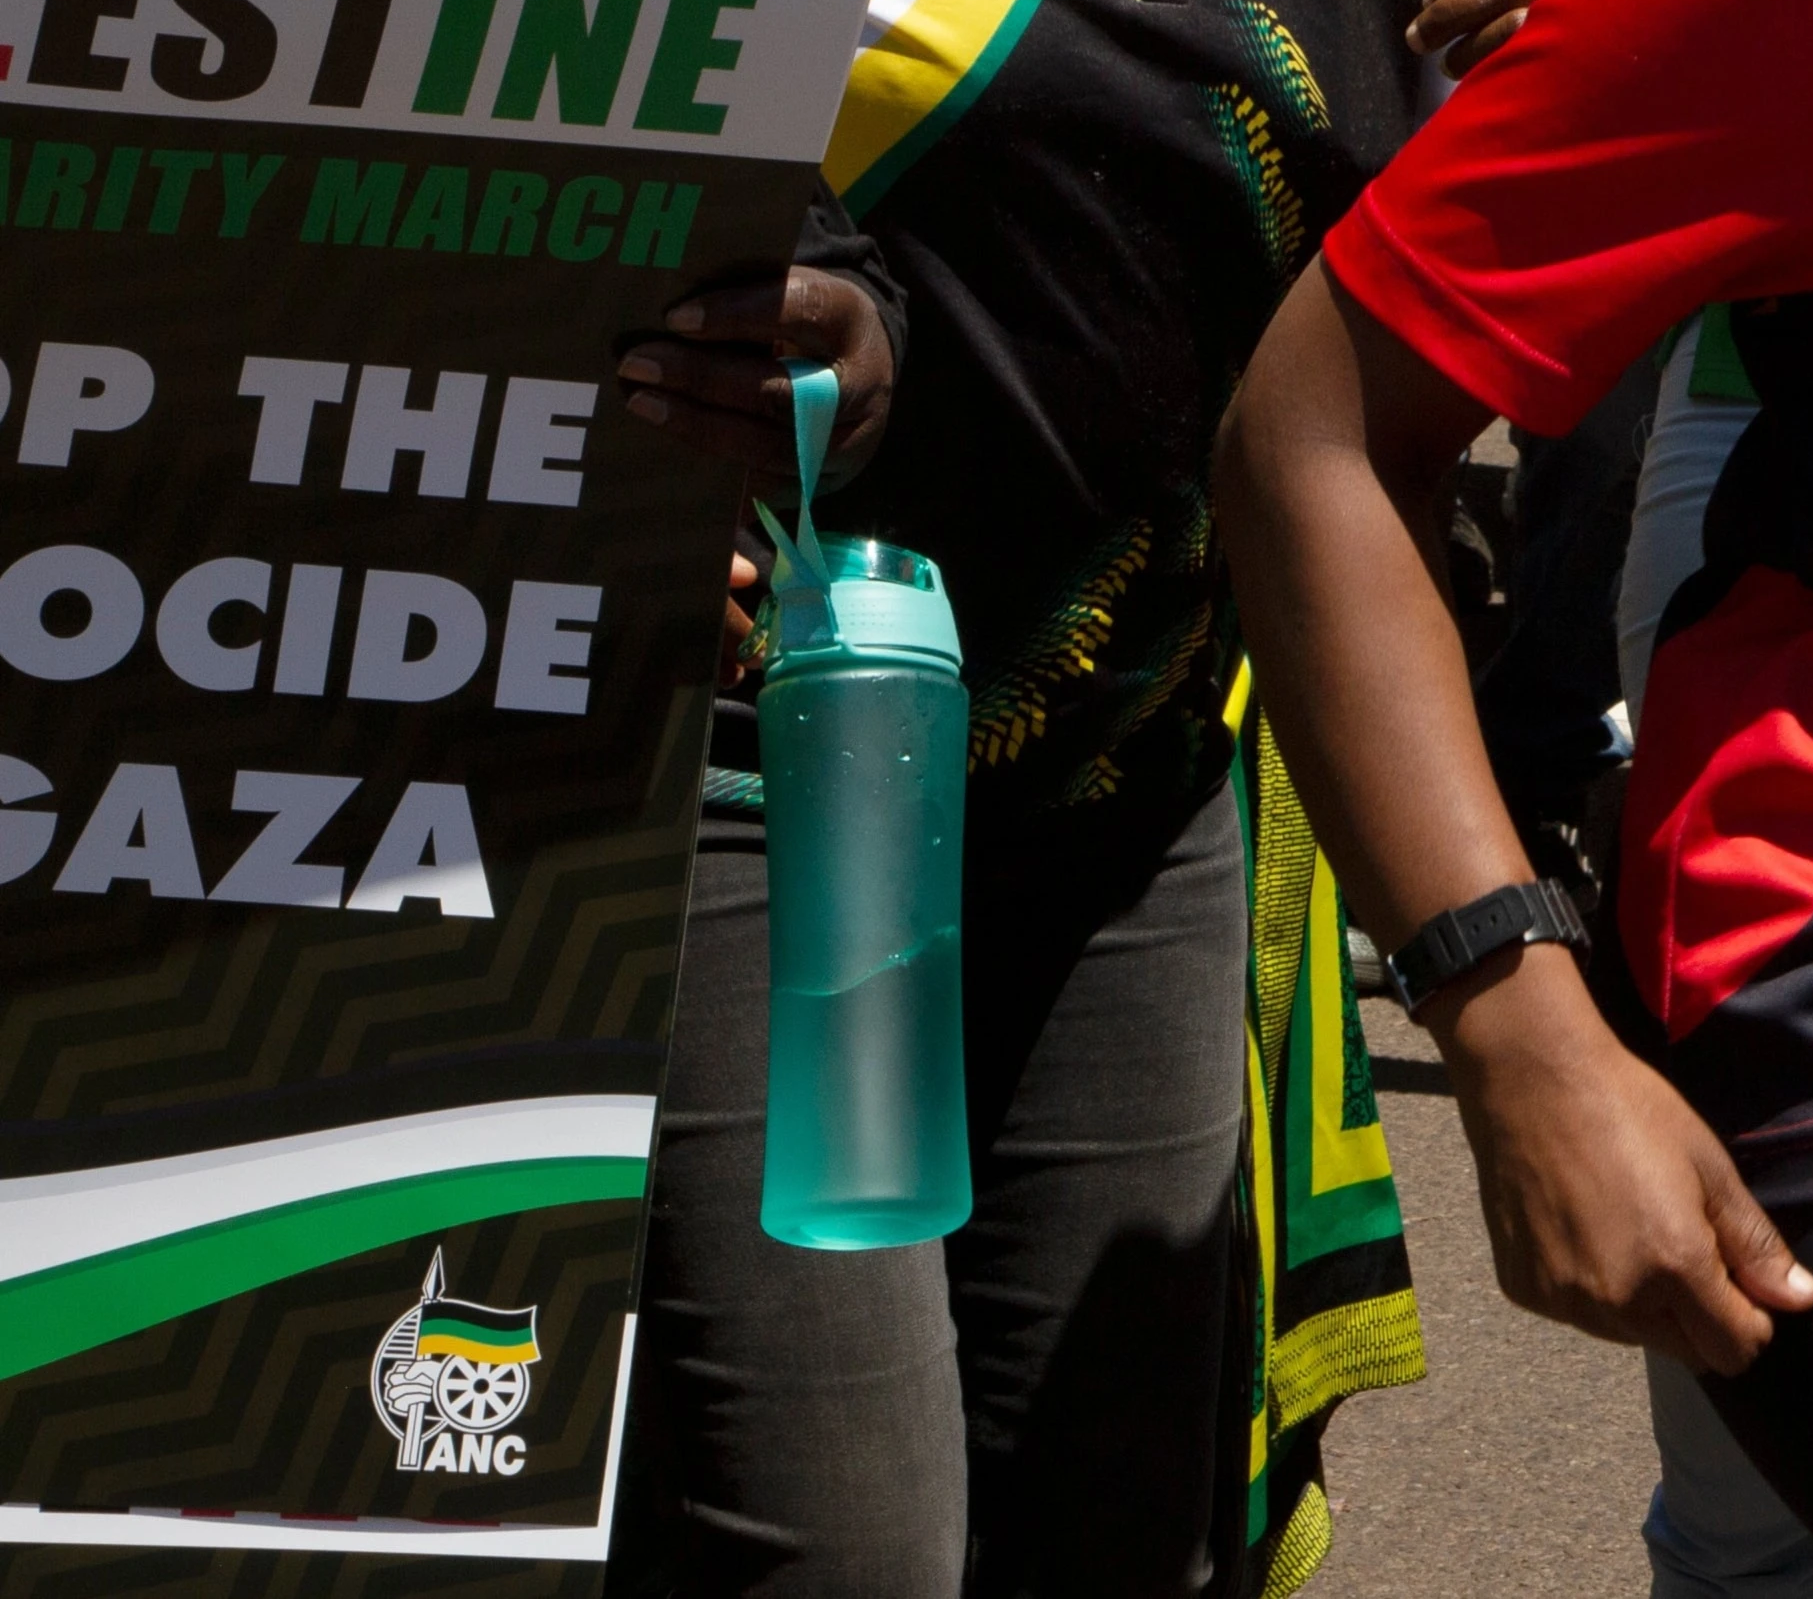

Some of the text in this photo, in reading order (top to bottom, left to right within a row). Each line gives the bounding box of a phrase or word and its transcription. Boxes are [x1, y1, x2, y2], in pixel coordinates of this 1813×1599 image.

[299, 157, 704, 269] MARCH
[237, 356, 600, 507] THE
[423, 1431, 527, 1477] ANC
